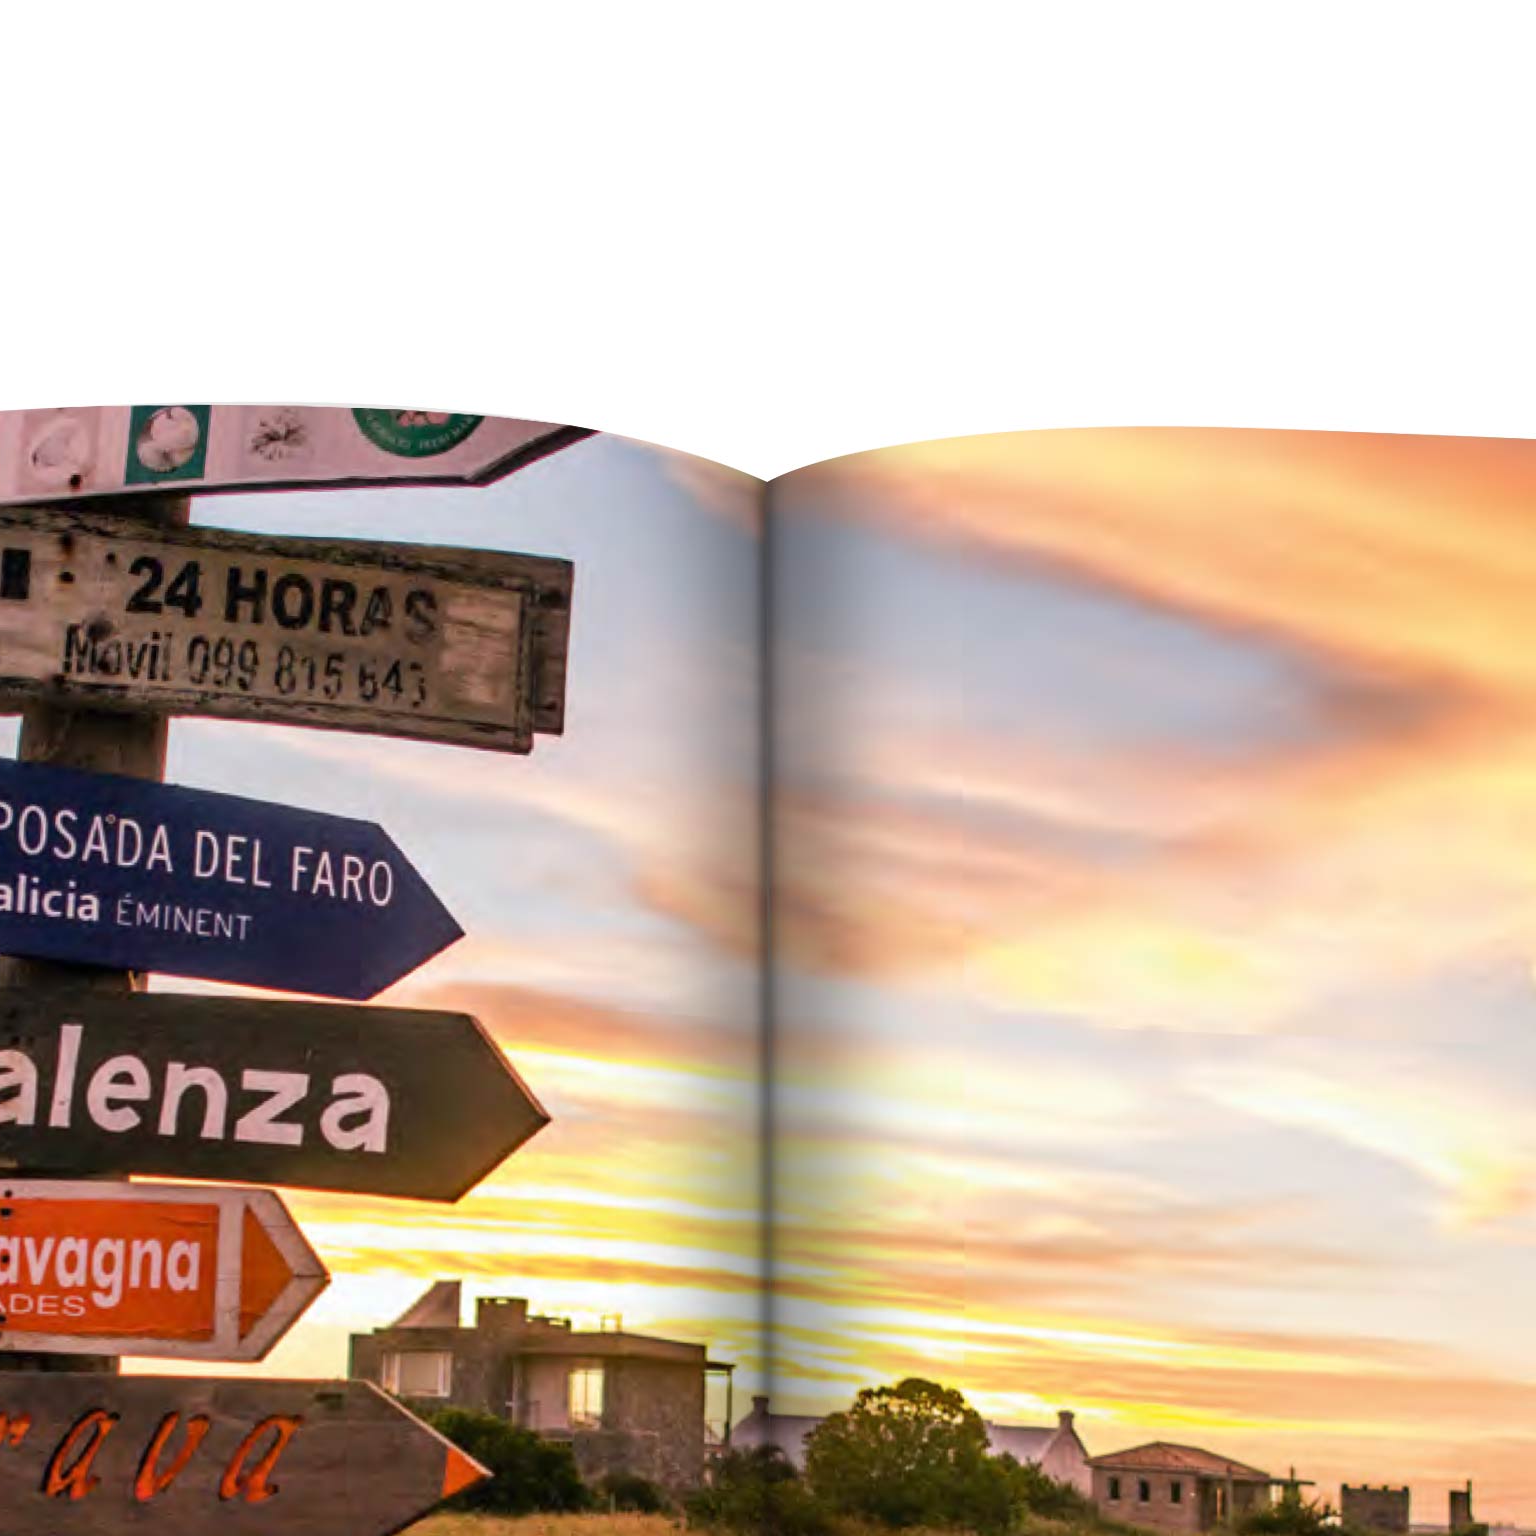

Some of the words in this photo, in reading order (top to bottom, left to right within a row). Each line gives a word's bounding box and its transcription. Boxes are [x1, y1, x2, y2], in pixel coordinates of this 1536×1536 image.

[125, 555, 203, 618] 24
[224, 566, 440, 645] HORAS
[193, 830, 272, 889] DEL
[290, 846, 395, 907] FARO
[115, 898, 253, 941] ÉMINENT
